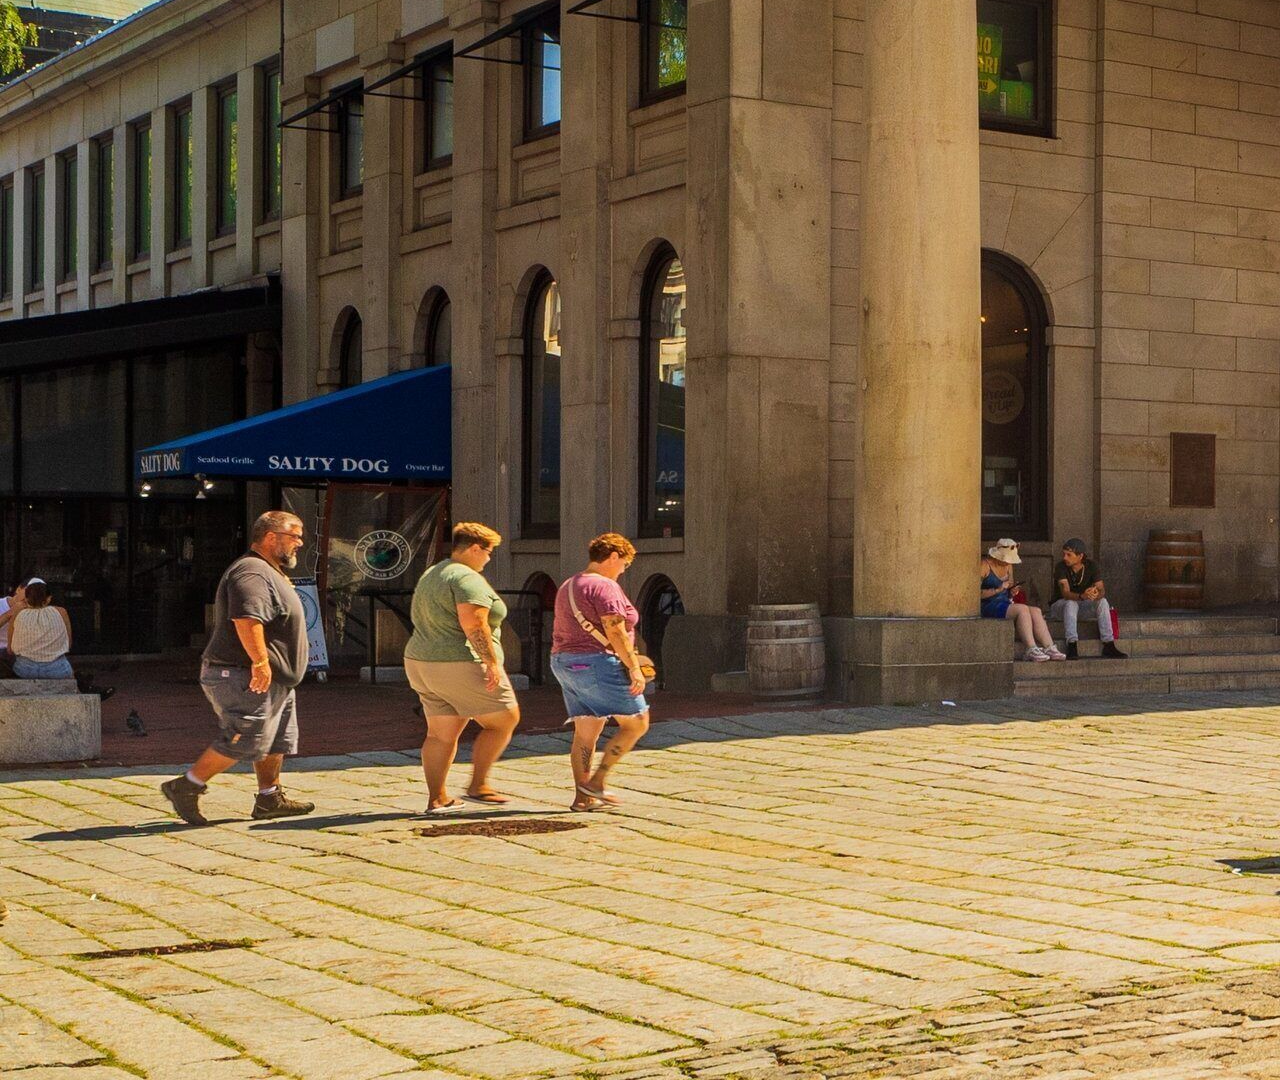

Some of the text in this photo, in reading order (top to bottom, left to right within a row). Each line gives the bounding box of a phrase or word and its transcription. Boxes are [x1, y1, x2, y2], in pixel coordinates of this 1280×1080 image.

[140, 452, 181, 474] SALTY DOG
[197, 455, 255, 465] Seafood Grille
[268, 455, 390, 473] SALTY DOG
[405, 462, 445, 472] Oyster Bar
